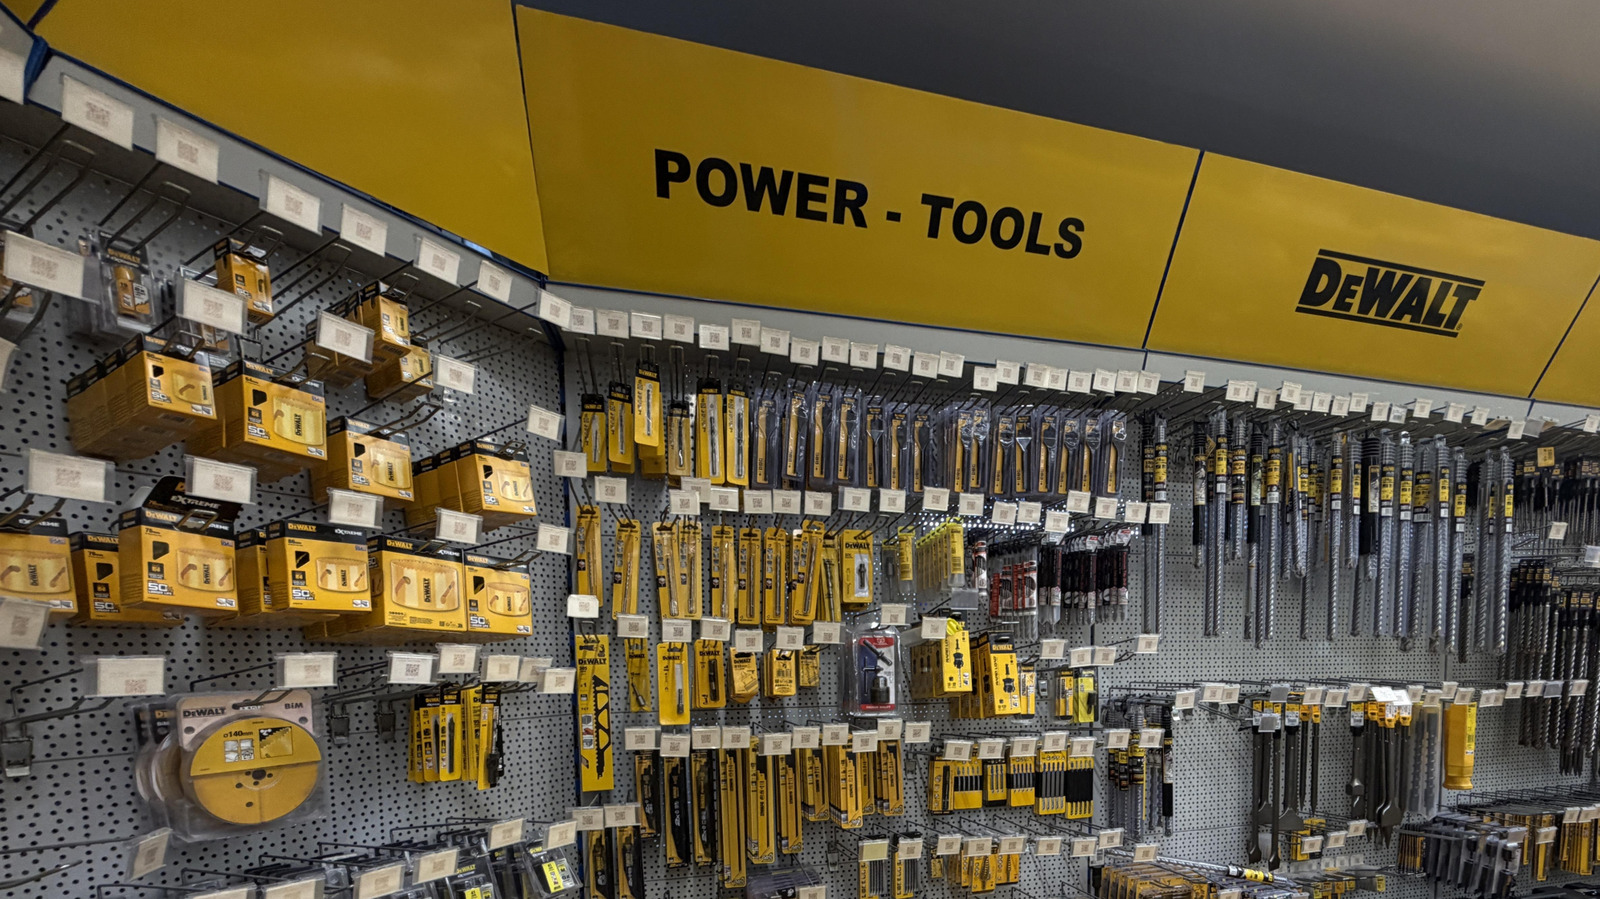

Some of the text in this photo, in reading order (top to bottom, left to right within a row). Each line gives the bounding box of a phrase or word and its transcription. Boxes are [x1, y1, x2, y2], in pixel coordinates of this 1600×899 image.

[654, 148, 1085, 259] POWER - TOOLS
[171, 495, 221, 510] EXTREME
[334, 528, 363, 537] EXTREME
